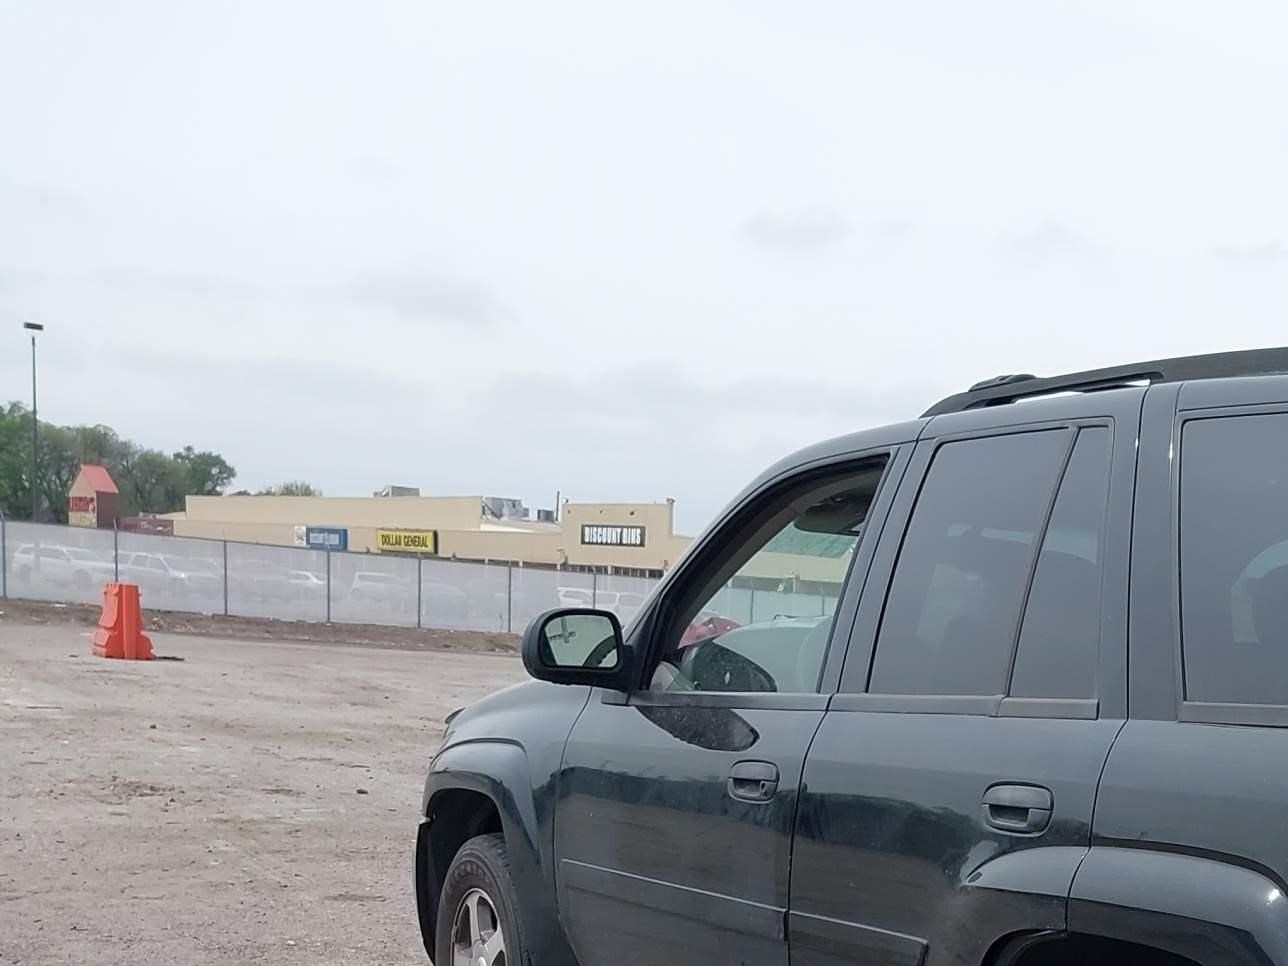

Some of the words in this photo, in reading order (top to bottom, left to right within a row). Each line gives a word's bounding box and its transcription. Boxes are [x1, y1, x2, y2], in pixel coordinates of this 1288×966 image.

[403, 535, 428, 547] GENERAL
[584, 527, 621, 544] DISCOUNT
[622, 528, 641, 545] BINS
